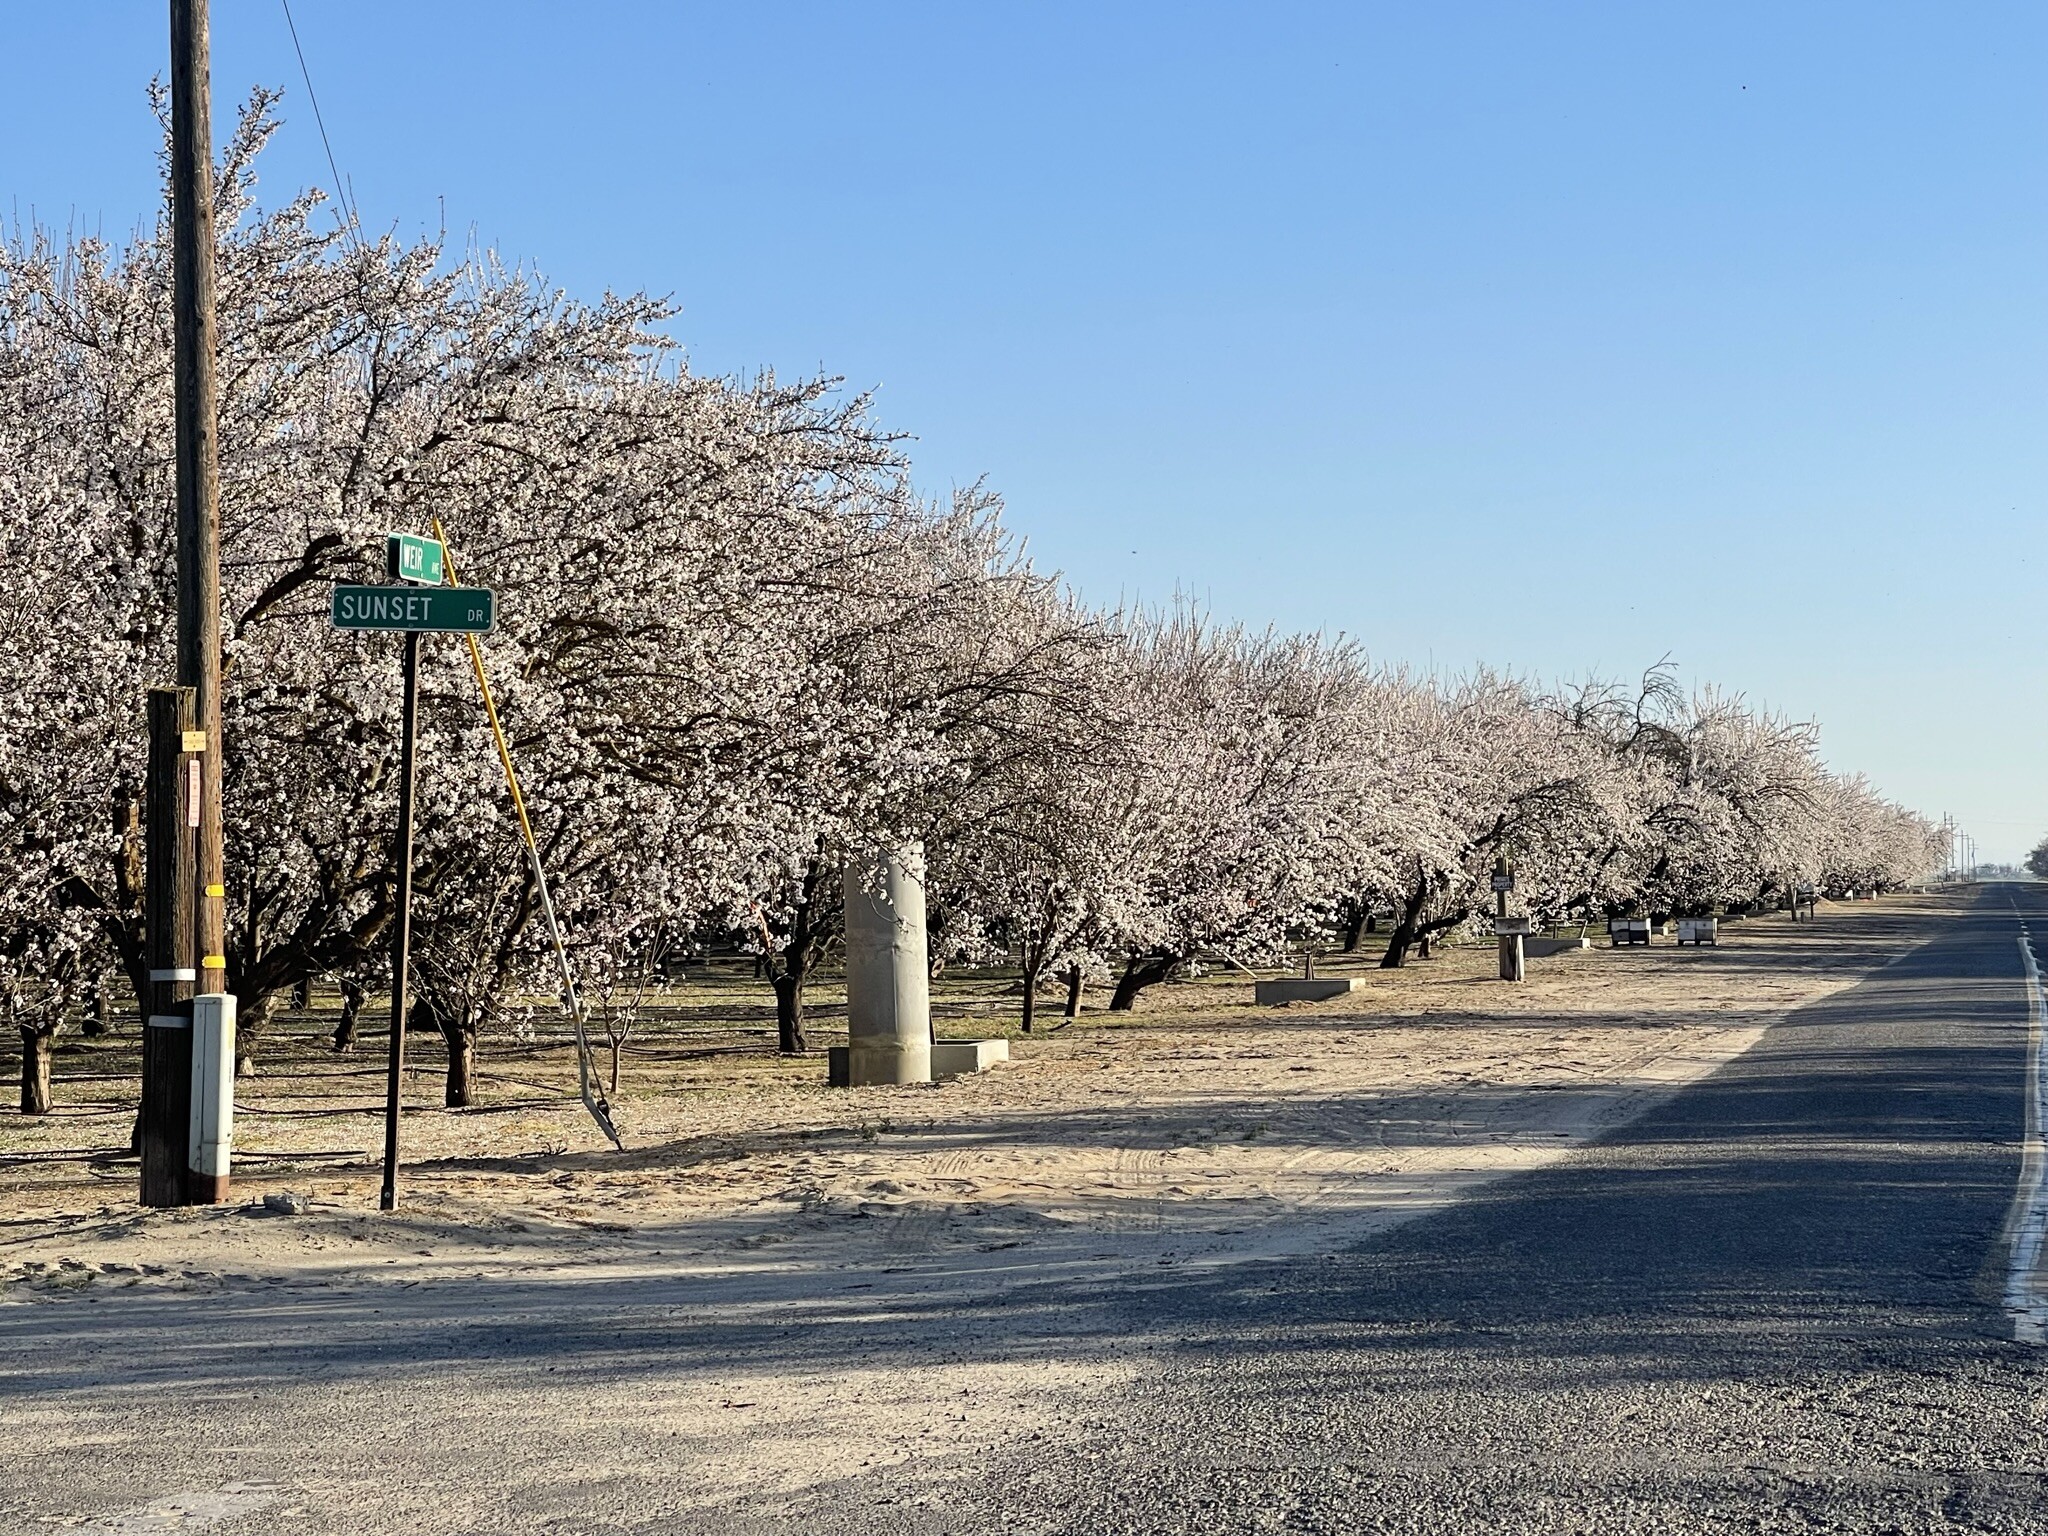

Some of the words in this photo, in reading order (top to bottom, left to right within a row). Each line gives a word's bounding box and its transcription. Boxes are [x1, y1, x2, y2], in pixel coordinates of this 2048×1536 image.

[403, 543, 423, 571] WEIR
[431, 562, 439, 575] AVE
[341, 595, 432, 620] SUNSET
[467, 609, 483, 622] DR
